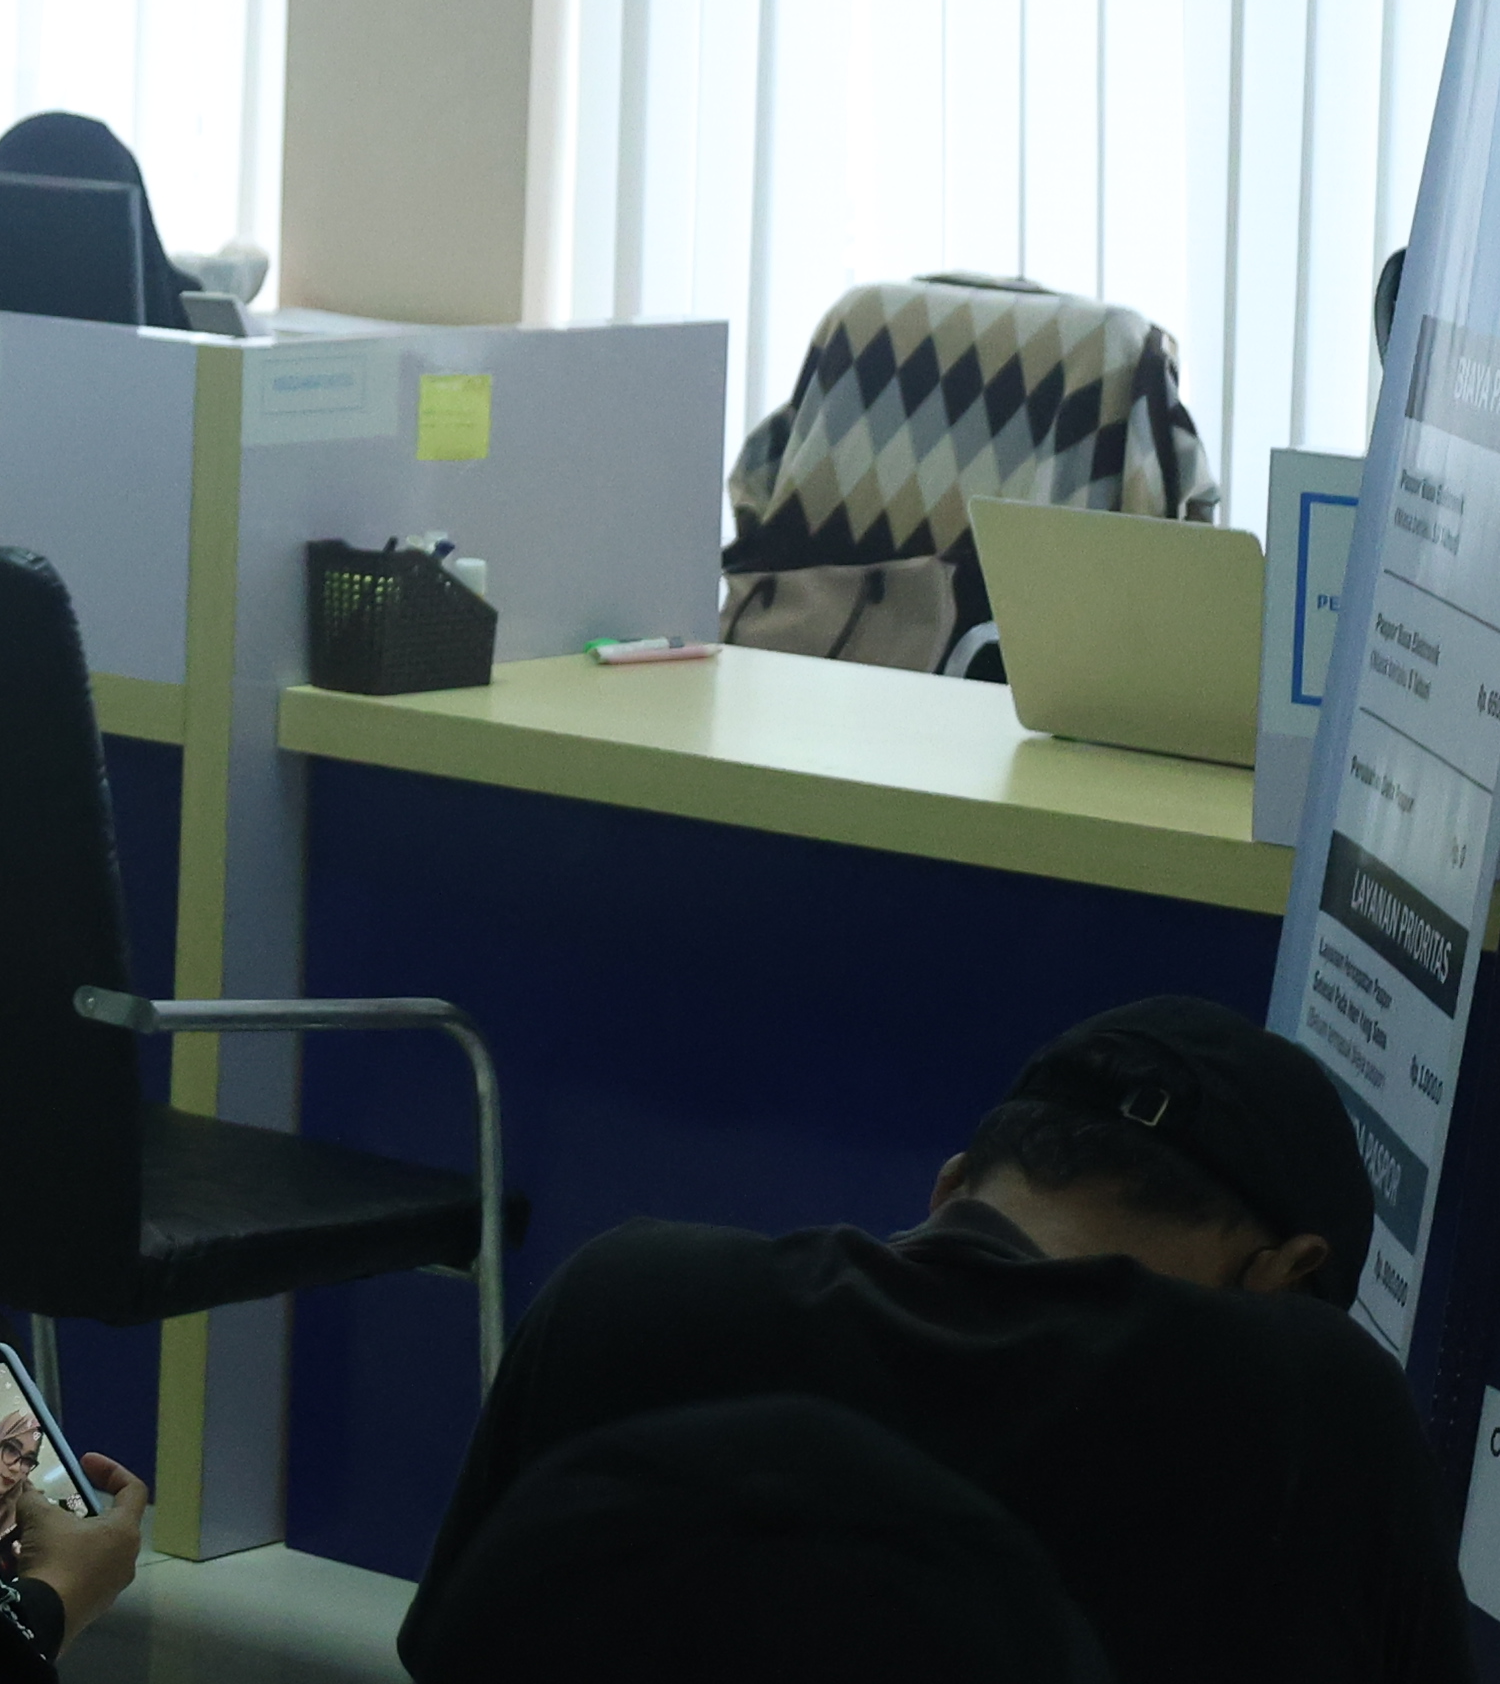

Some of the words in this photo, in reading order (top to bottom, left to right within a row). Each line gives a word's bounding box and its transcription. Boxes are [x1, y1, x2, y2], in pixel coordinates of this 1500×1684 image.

[1454, 357, 1491, 410] BIAYA
[1351, 868, 1401, 944] LAYANAN
[1400, 905, 1452, 985] PRIORITAS
